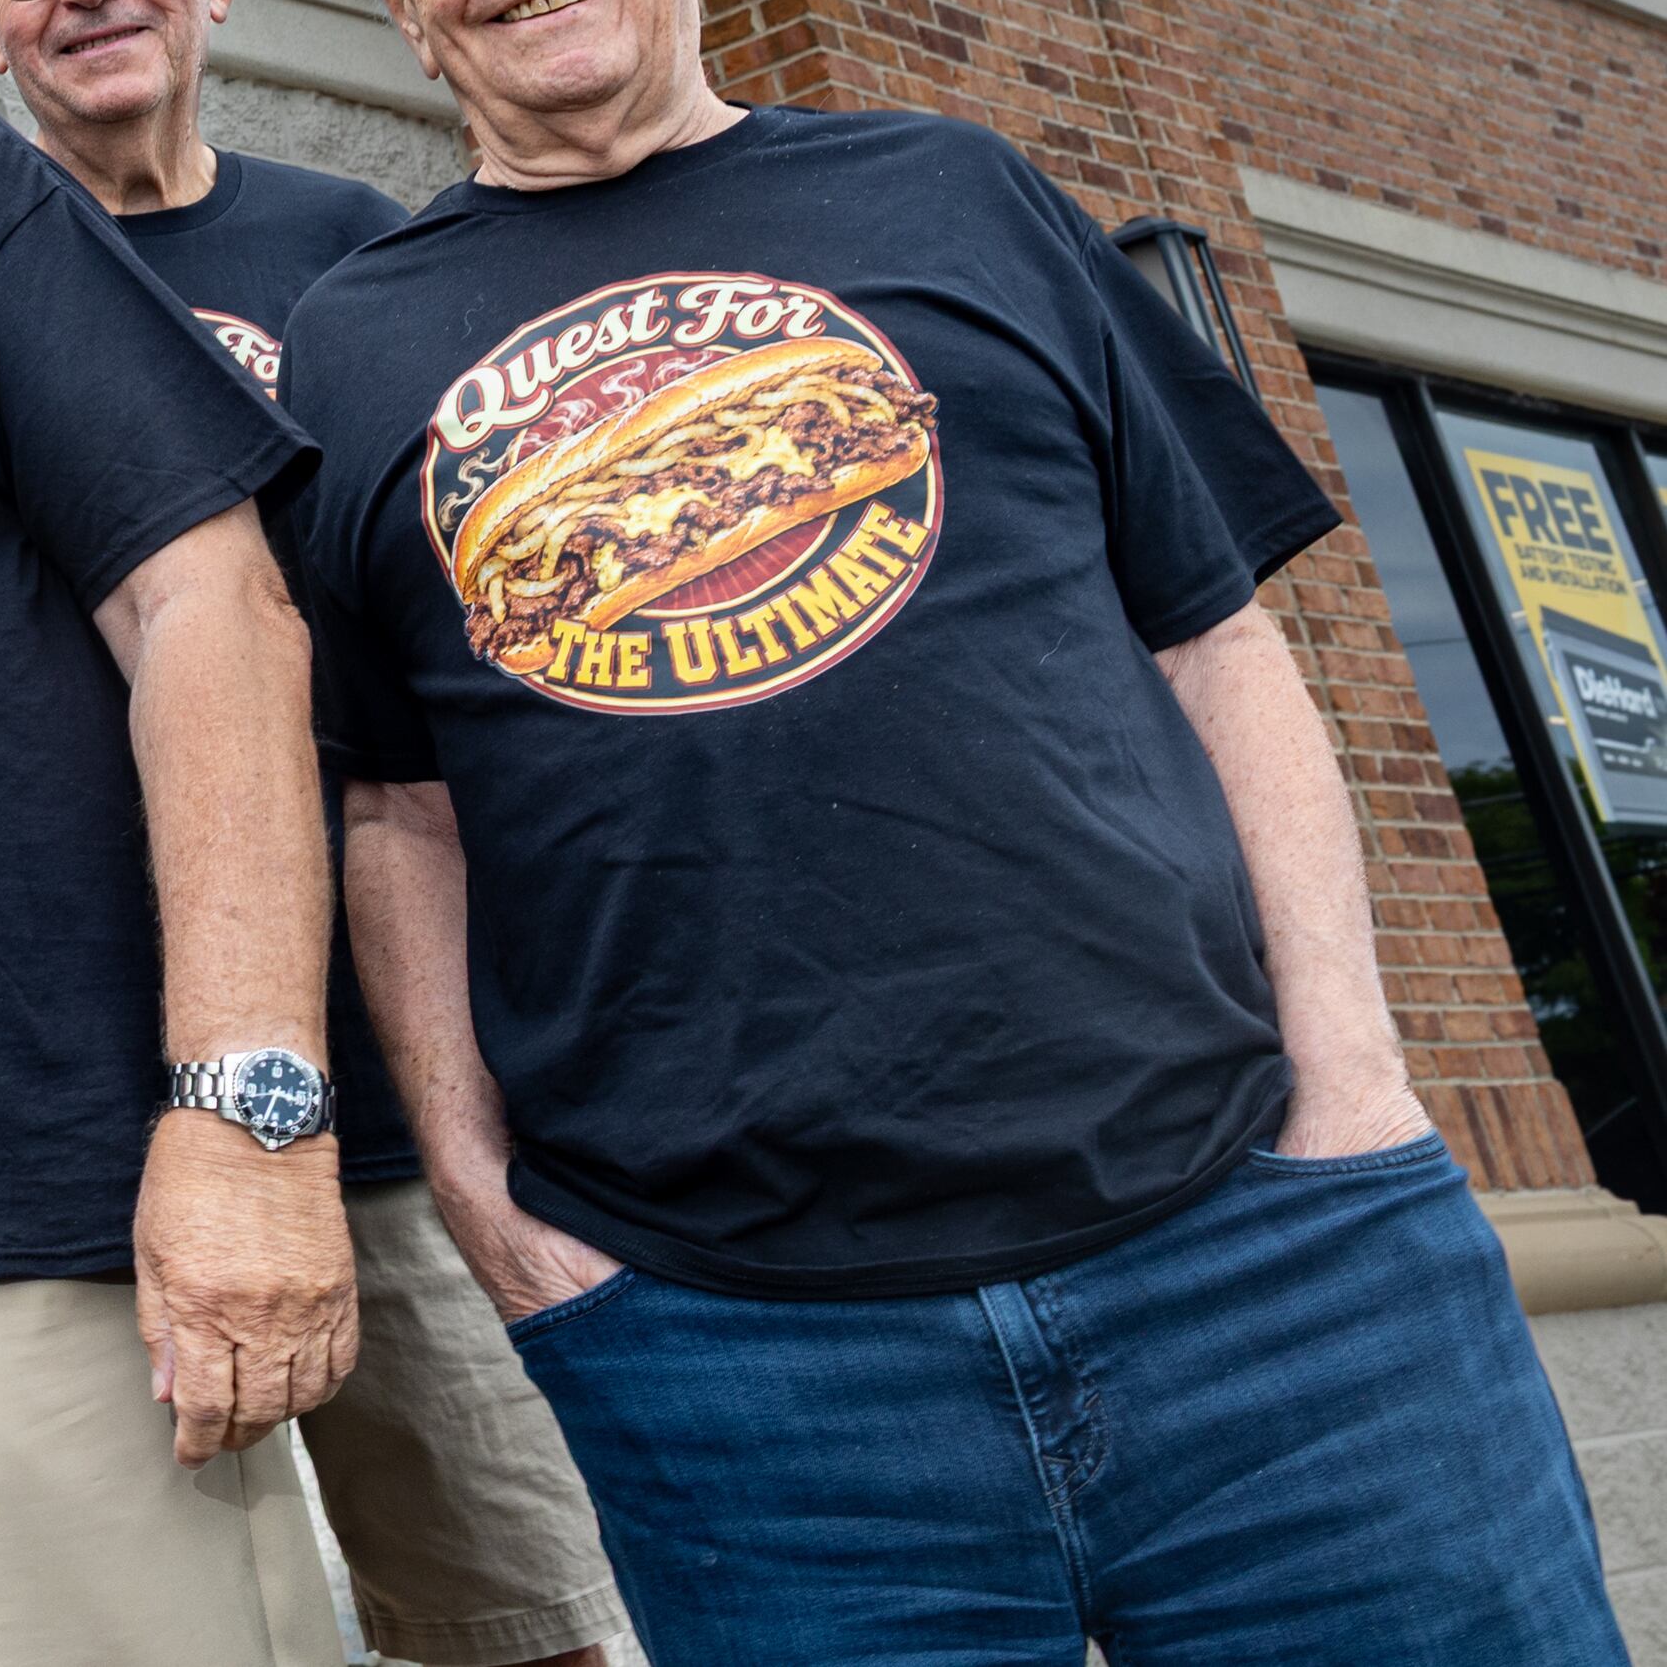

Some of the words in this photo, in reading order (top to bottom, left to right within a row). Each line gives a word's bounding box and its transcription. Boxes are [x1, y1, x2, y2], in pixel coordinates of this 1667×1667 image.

[440, 289, 665, 450] Quest
[675, 280, 824, 343] For
[1480, 469, 1614, 554] FREE
[545, 619, 652, 688] THE
[665, 501, 930, 684] ULTIMATE
[1573, 665, 1657, 718] DieHard
